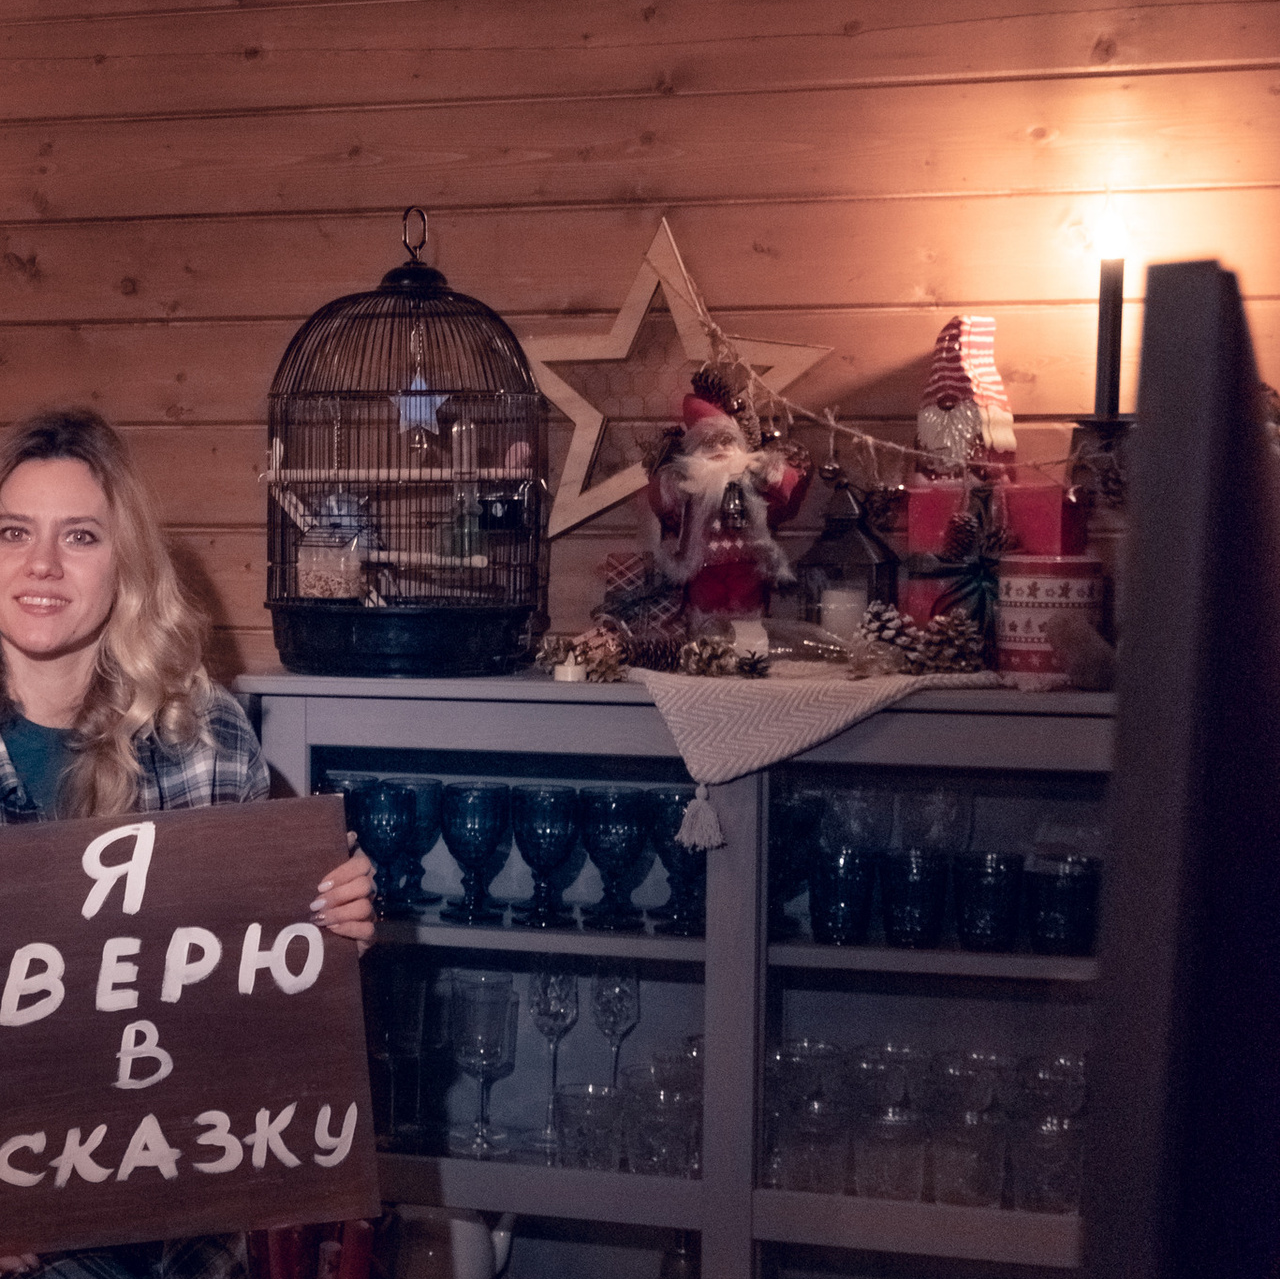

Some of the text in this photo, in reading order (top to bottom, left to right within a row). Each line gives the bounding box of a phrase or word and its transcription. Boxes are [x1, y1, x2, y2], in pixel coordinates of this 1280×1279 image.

[81, 821, 156, 920] Я
[0, 922, 324, 1027] ВЕРЮ
[111, 1019, 174, 1089] В
